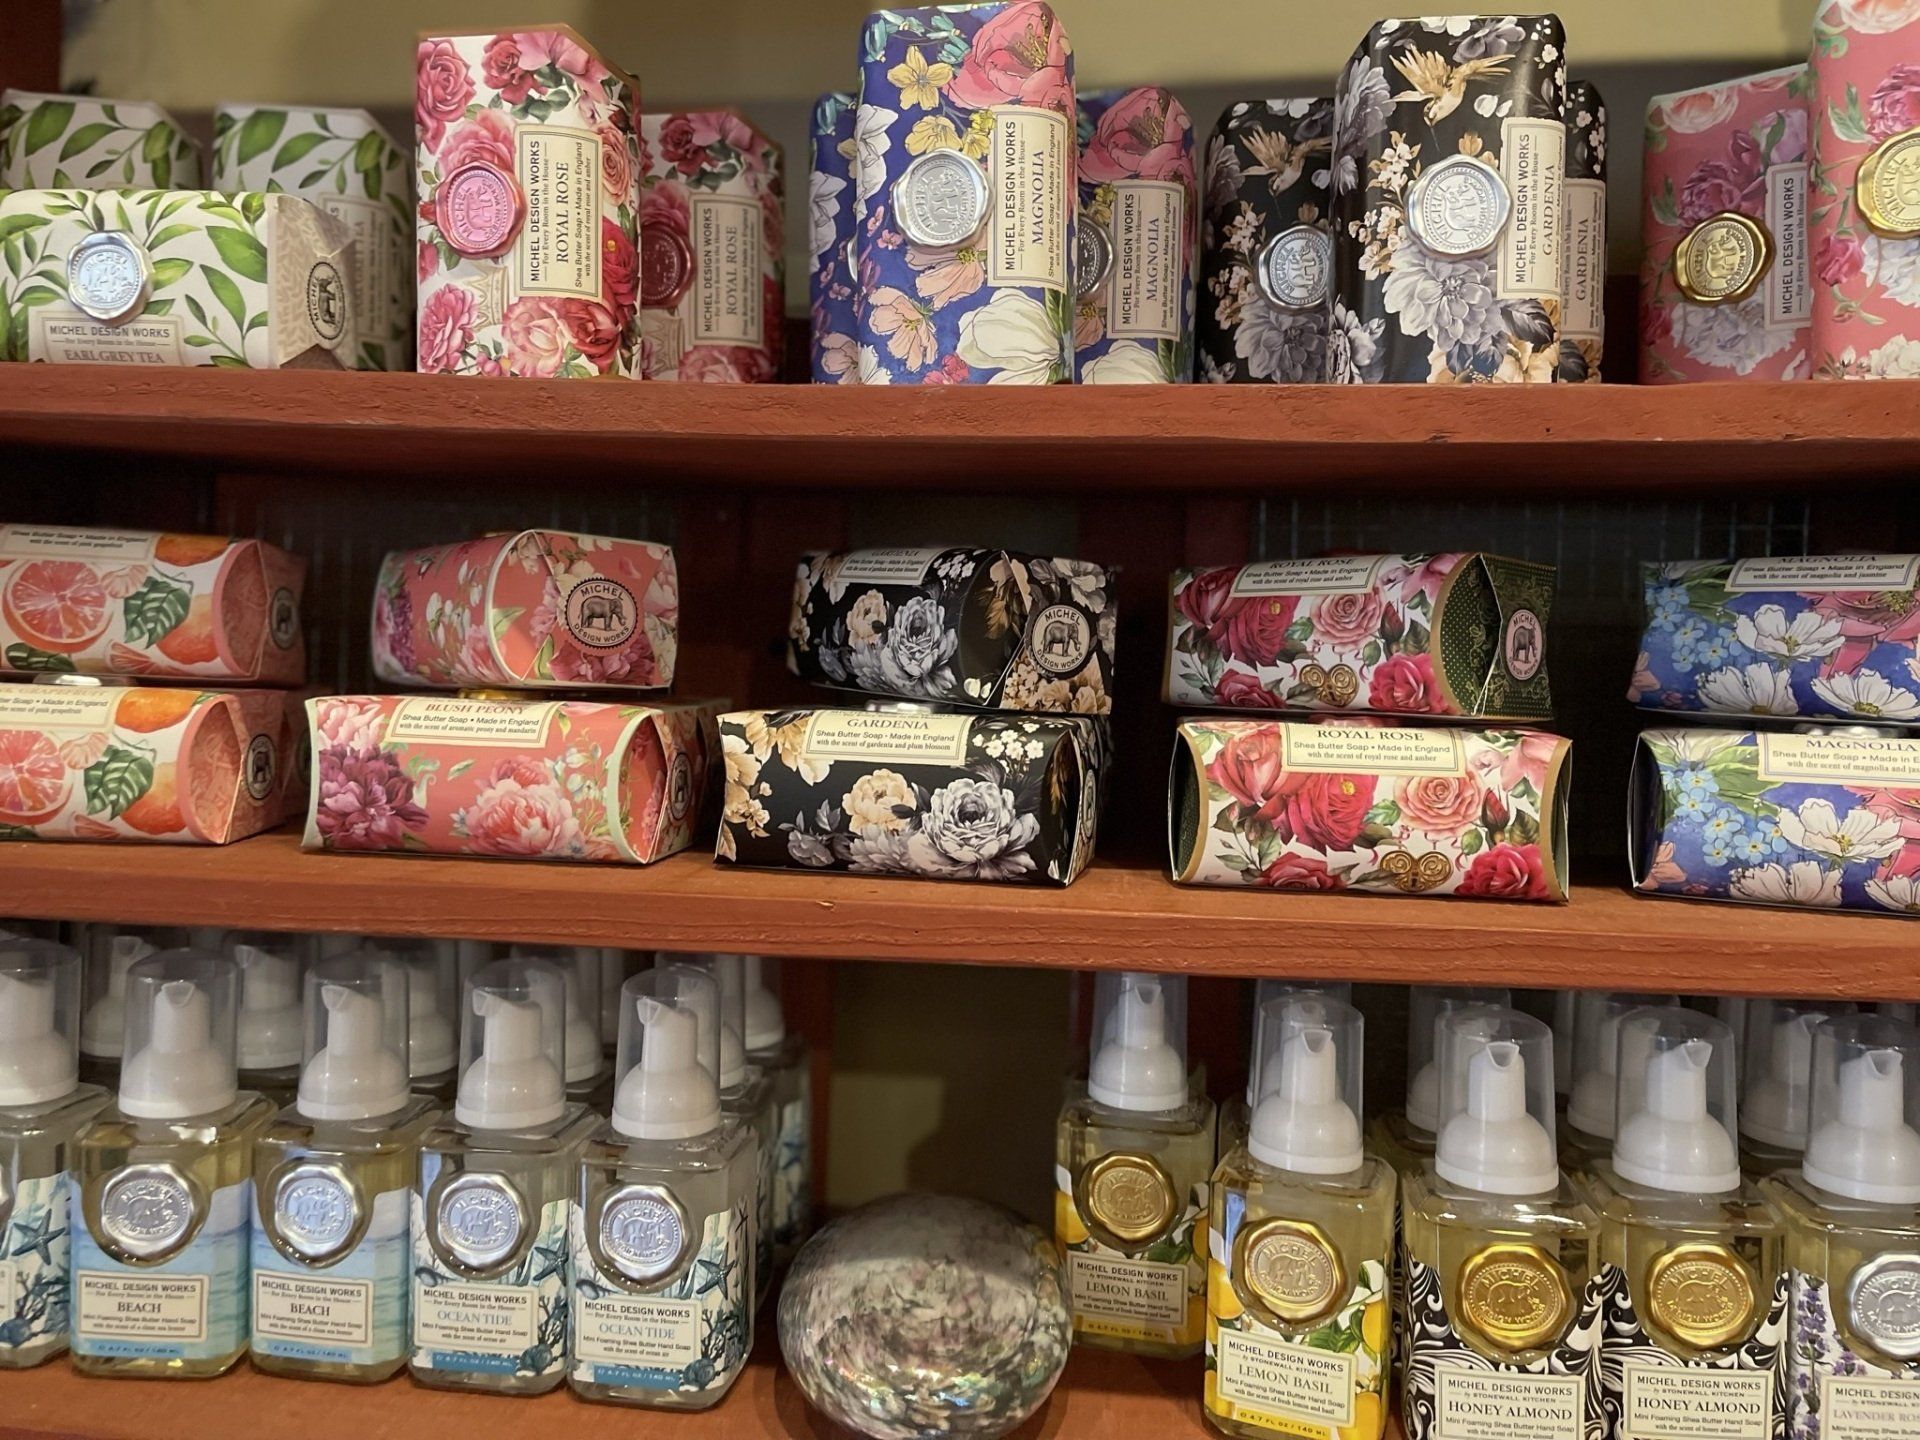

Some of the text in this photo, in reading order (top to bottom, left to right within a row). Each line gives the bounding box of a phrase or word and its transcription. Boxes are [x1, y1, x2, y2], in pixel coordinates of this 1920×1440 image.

[575, 142, 583, 174] England
[1049, 160, 1055, 168] in
[1019, 180, 1026, 188] in
[1881, 158, 1908, 216] MICHEL
[575, 186, 583, 209] Made
[1005, 121, 1016, 270] MICHEL DESIGN WORKS
[1032, 151, 1045, 245] MAGNOLIA
[531, 141, 540, 281] MICHEL DESIGN WORKS
[542, 158, 550, 264] For Every Room in the House
[556, 162, 570, 263] ROYAL ROSE
[1516, 134, 1530, 282] MICHEL DESIGN WORKS
[1543, 165, 1554, 255] GARDENIA
[1782, 178, 1794, 314] MICHEL DESIGN WORKS
[1122, 194, 1134, 324] MICHEL DESIGN WORKS
[1147, 218, 1159, 300] MAGNOLIA
[1576, 218, 1588, 300] GARDENIA
[704, 208, 712, 331] MICHEL DESIGN WORKS
[726, 226, 737, 314] ROYAL ROSE
[49, 325, 169, 338] MICHEL DESIGN WORKS
[64, 348, 164, 364] EARL GREY TEA
[581, 584, 624, 600] MICHEL
[1045, 609, 1081, 626] MICHEL
[1513, 614, 1537, 630] MICHEL
[574, 623, 630, 642] DESIGN WORKS
[1037, 649, 1083, 669] DESIGN WORKS
[425, 703, 525, 715] BLUSH PEONY
[401, 714, 539, 727] Shea Butter Soap Made in England
[847, 719, 929, 730] GARDENIA
[816, 730, 954, 743] Shea Butter Soap Made in England
[1318, 729, 1424, 741] ROYAL ROSE
[1294, 742, 1450, 754] Shea Butter Soap Made in England
[1806, 740, 1917, 751] MAGNOLIA
[1077, 1262, 1177, 1282] MICHEL DESIGN WORKS
[1481, 1269, 1540, 1291] MICHEL
[85, 1281, 195, 1292] MICHEL DESIGN WORKS
[261, 1281, 361, 1297] MICHEL DESIGN WORKS
[1086, 1281, 1168, 1301] LEMON BASIL
[424, 1289, 526, 1304] MICHEL DESIGN WORKS
[117, 1302, 160, 1314] BEACH
[290, 1303, 330, 1317] BEACH
[585, 1301, 689, 1318] MICHEL DESIGN WORKS
[438, 1311, 511, 1326] OCEAN TIDE
[599, 1324, 674, 1339] OCEAN TIDE
[1228, 1341, 1343, 1372] MICHEL DESIGN WORKS
[1238, 1364, 1333, 1394] LEMON BASIL
[1448, 1379, 1572, 1396] MICHEL DESIGN WORKS
[1637, 1376, 1760, 1390] MICHEL DESIGN WORKS
[1836, 1388, 1919, 1399] MICHEL DESIGN
[1449, 1401, 1572, 1420] HONEY ALMOND
[1638, 1398, 1760, 1414] HONEY ALMOND
[1446, 1416, 1574, 1433] Mini Foaming Shea Butter Hand Soap
